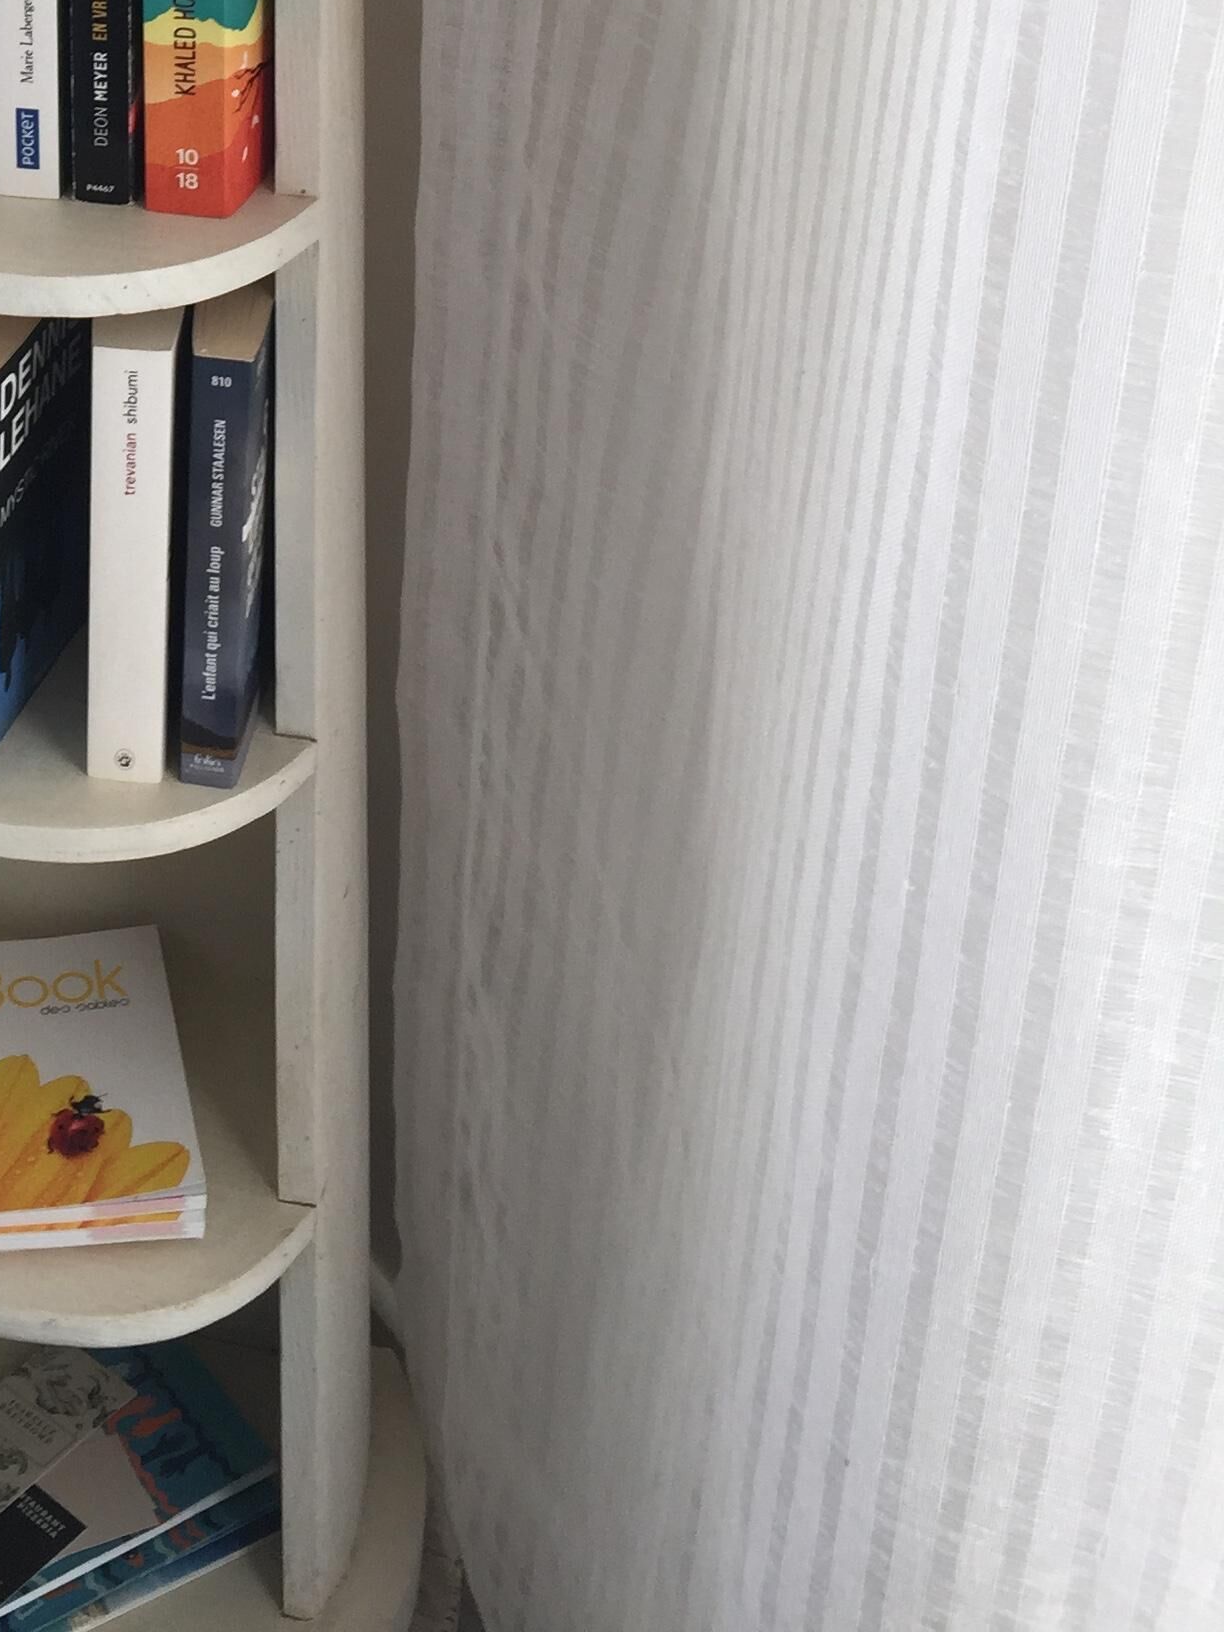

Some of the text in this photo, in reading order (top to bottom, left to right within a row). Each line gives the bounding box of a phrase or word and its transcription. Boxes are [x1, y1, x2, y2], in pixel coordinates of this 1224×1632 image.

[19, 0, 35, 84] Marie Laberge
[92, 20, 107, 41] EN
[173, 27, 197, 96] KHALED
[93, 51, 109, 147] DEON MEYER
[175, 148, 199, 165] 10
[175, 172, 199, 190] 18
[122, 370, 138, 496] trevanian shibumi
[210, 419, 226, 527] GUNNAR STAALESEN
[201, 546, 225, 701] L'enfant qui criait au loup
[40, 997, 130, 1016] des sables
